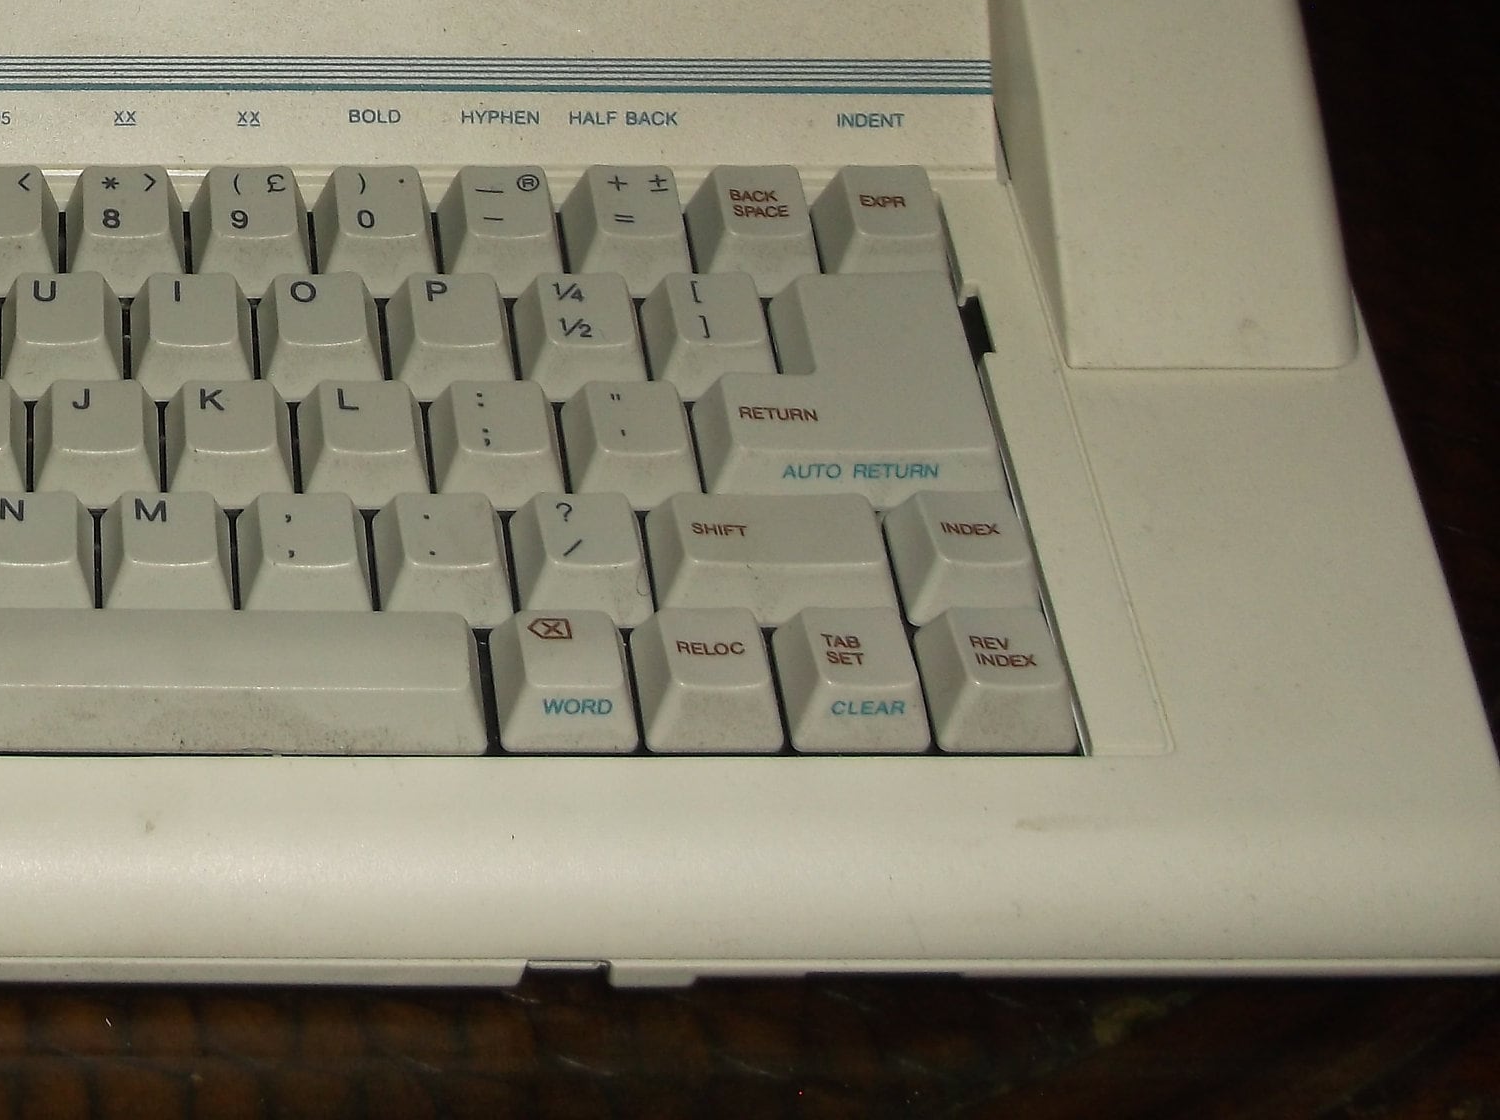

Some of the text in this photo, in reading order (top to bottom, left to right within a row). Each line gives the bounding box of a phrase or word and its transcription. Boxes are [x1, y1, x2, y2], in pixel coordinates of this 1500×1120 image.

[349, 109, 401, 123] BOLD
[462, 110, 539, 124] HYPHEN
[570, 111, 677, 126] HALF BACK
[837, 113, 904, 128] INDENT
[18, 173, 30, 191] <
[144, 174, 156, 191] >
[234, 174, 285, 195] ( £
[359, 173, 365, 194] )
[608, 176, 627, 191] +
[730, 189, 778, 203] BACK
[860, 195, 906, 207] EXPR
[103, 209, 120, 228] 8
[733, 205, 789, 217] SPACE
[231, 210, 248, 229] 9
[34, 280, 56, 302] U
[291, 281, 316, 303] O
[426, 281, 447, 302] P
[72, 389, 90, 409] J
[200, 389, 224, 411] K
[337, 388, 359, 411] L
[739, 406, 818, 421] RETURN
[783, 463, 939, 479] AUTO RETURN
[0, 498, 24, 521] N
[135, 499, 166, 522] M
[556, 503, 572, 522] ?
[692, 523, 746, 536] SHIFT
[941, 522, 1000, 535] INDEX
[676, 641, 745, 655] RELOC
[821, 634, 861, 648] TAB
[969, 636, 1008, 650] REV
[826, 650, 864, 665] SET
[975, 653, 1037, 667] INDEX
[544, 699, 612, 715] WORD
[831, 701, 905, 715] CLEAR
